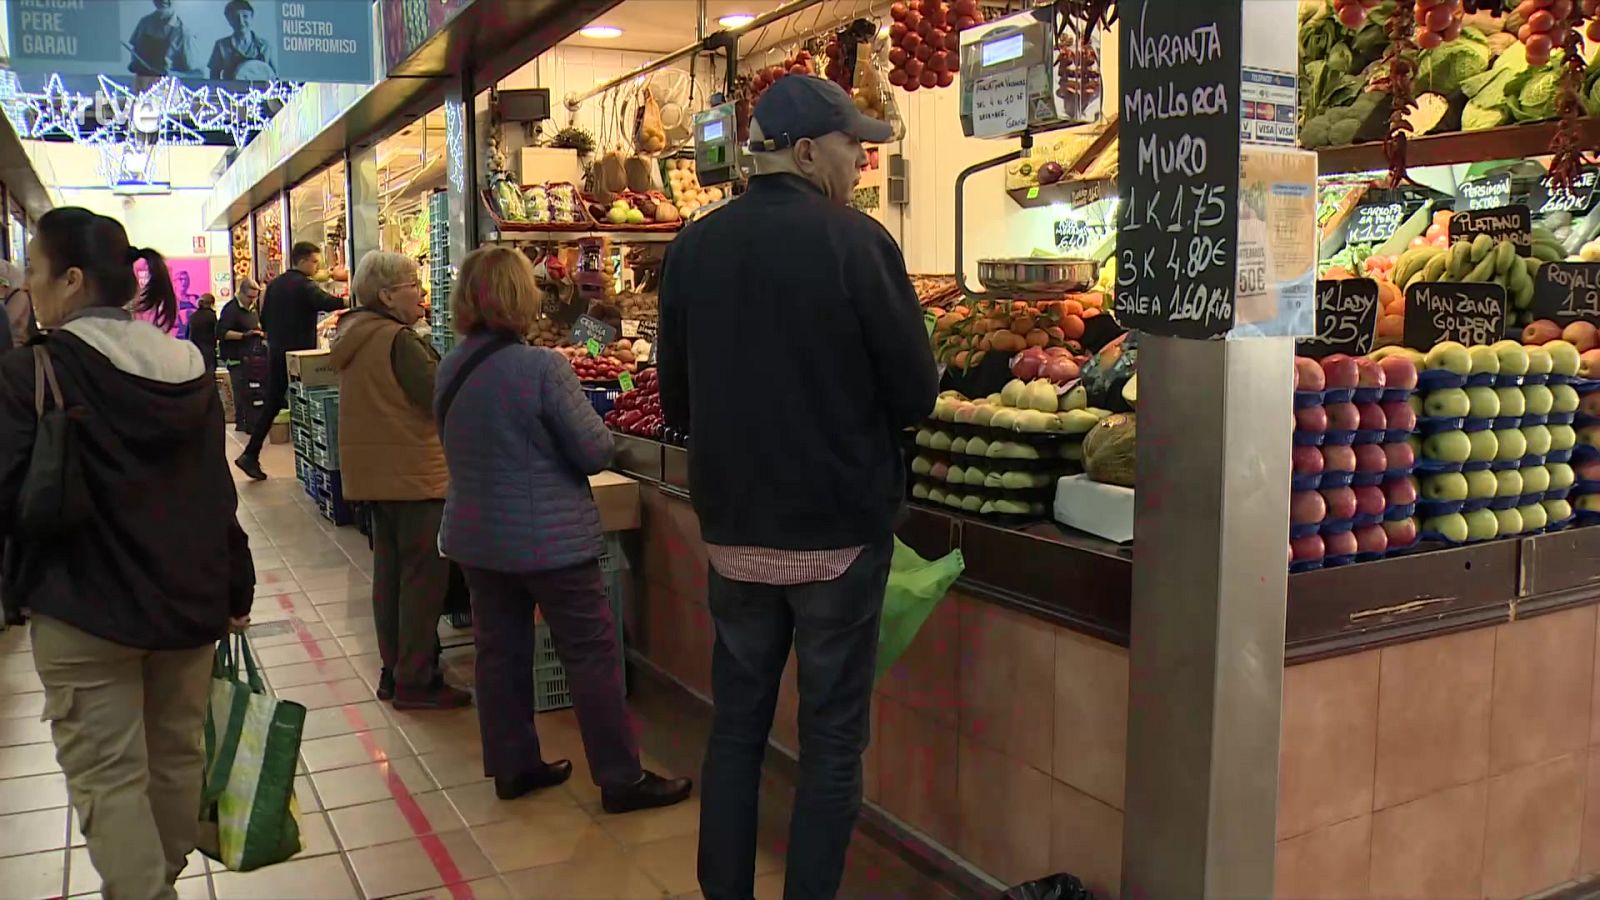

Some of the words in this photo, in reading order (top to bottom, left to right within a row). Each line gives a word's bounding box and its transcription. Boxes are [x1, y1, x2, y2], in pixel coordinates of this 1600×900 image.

[21, 11, 64, 32] PERE
[282, 3, 305, 18] CON
[282, 20, 334, 36] NUESTRO
[1129, 0, 1221, 70] NARANJA
[22, 34, 78, 56] GARAU
[283, 37, 357, 54] COMPROMISO
[1124, 81, 1228, 125] MALLORCA
[1258, 124, 1275, 134] VISA
[1278, 126, 1294, 137] VISA
[1138, 133, 1207, 184] MURO
[1123, 186, 1142, 231] 1
[1147, 190, 1161, 231] K
[1167, 183, 1226, 234] 1.75
[1453, 212, 1521, 232] PLATANO
[1118, 249, 1138, 287] 3
[1143, 246, 1156, 279] K
[1166, 236, 1227, 281] 4.80€
[1239, 266, 1266, 293] 50€
[1116, 285, 1151, 316] SALE
[1415, 287, 1501, 316] MANZANA
[1433, 311, 1501, 333] GOLDEN
